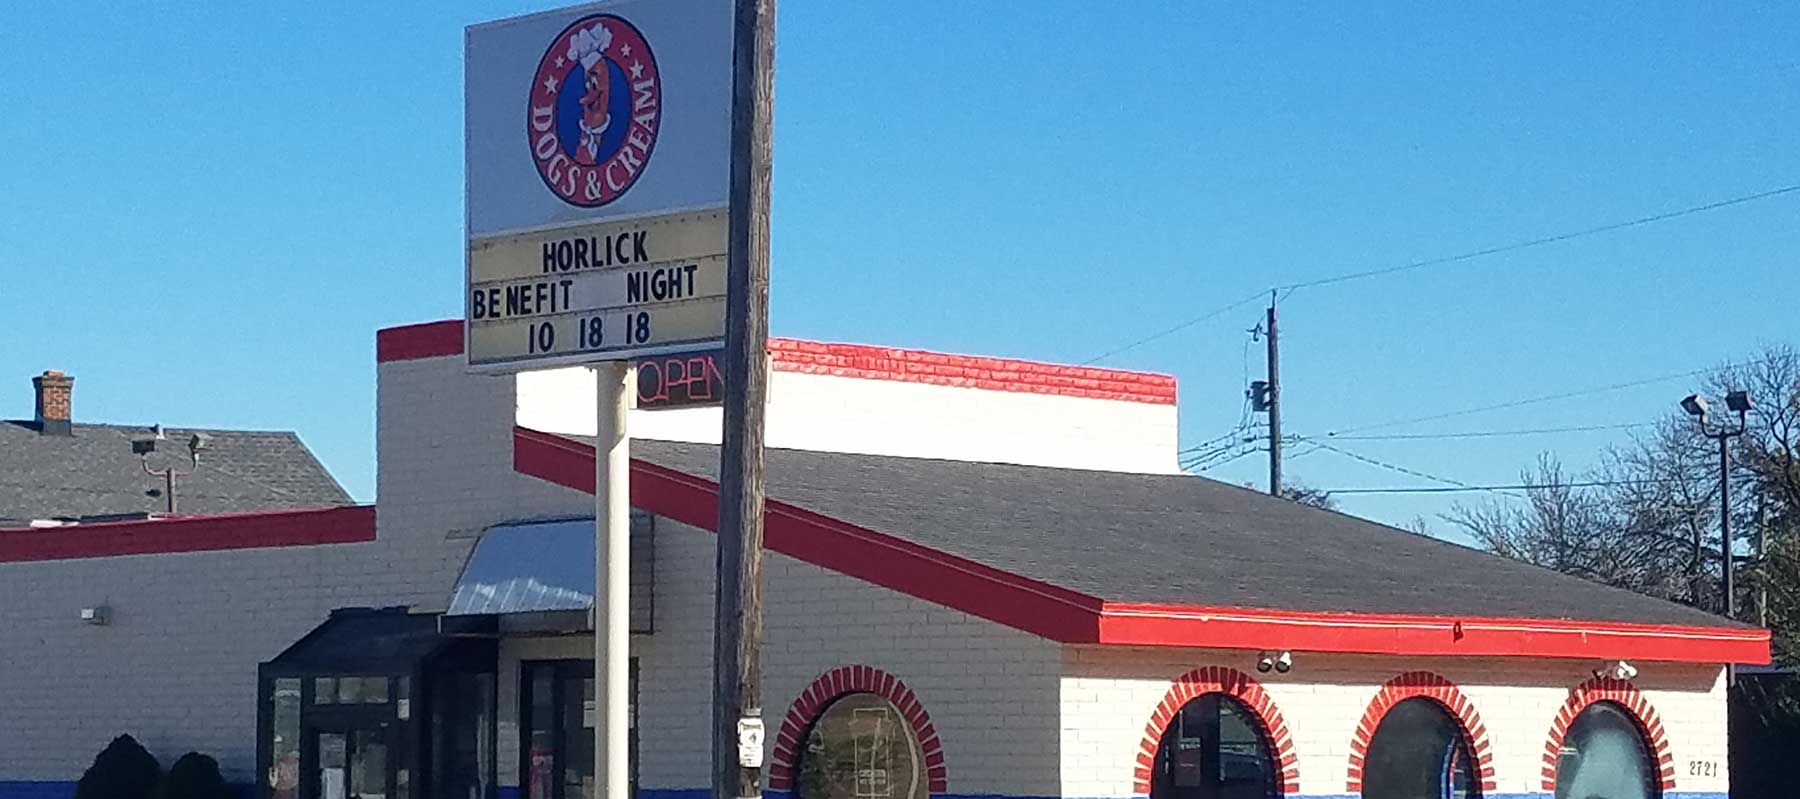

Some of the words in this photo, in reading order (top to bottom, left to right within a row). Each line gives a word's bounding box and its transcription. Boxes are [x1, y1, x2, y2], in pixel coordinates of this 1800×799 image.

[532, 104, 581, 197] DOGS
[584, 170, 602, 200] &
[605, 76, 658, 193] CREAM
[542, 230, 649, 273] HORLICK
[472, 279, 573, 320] BENEFIT
[626, 264, 698, 304] NIGHT
[528, 321, 555, 354] 10
[579, 316, 603, 349] 18
[625, 311, 650, 345] 18
[1689, 760, 1718, 778] 2721
